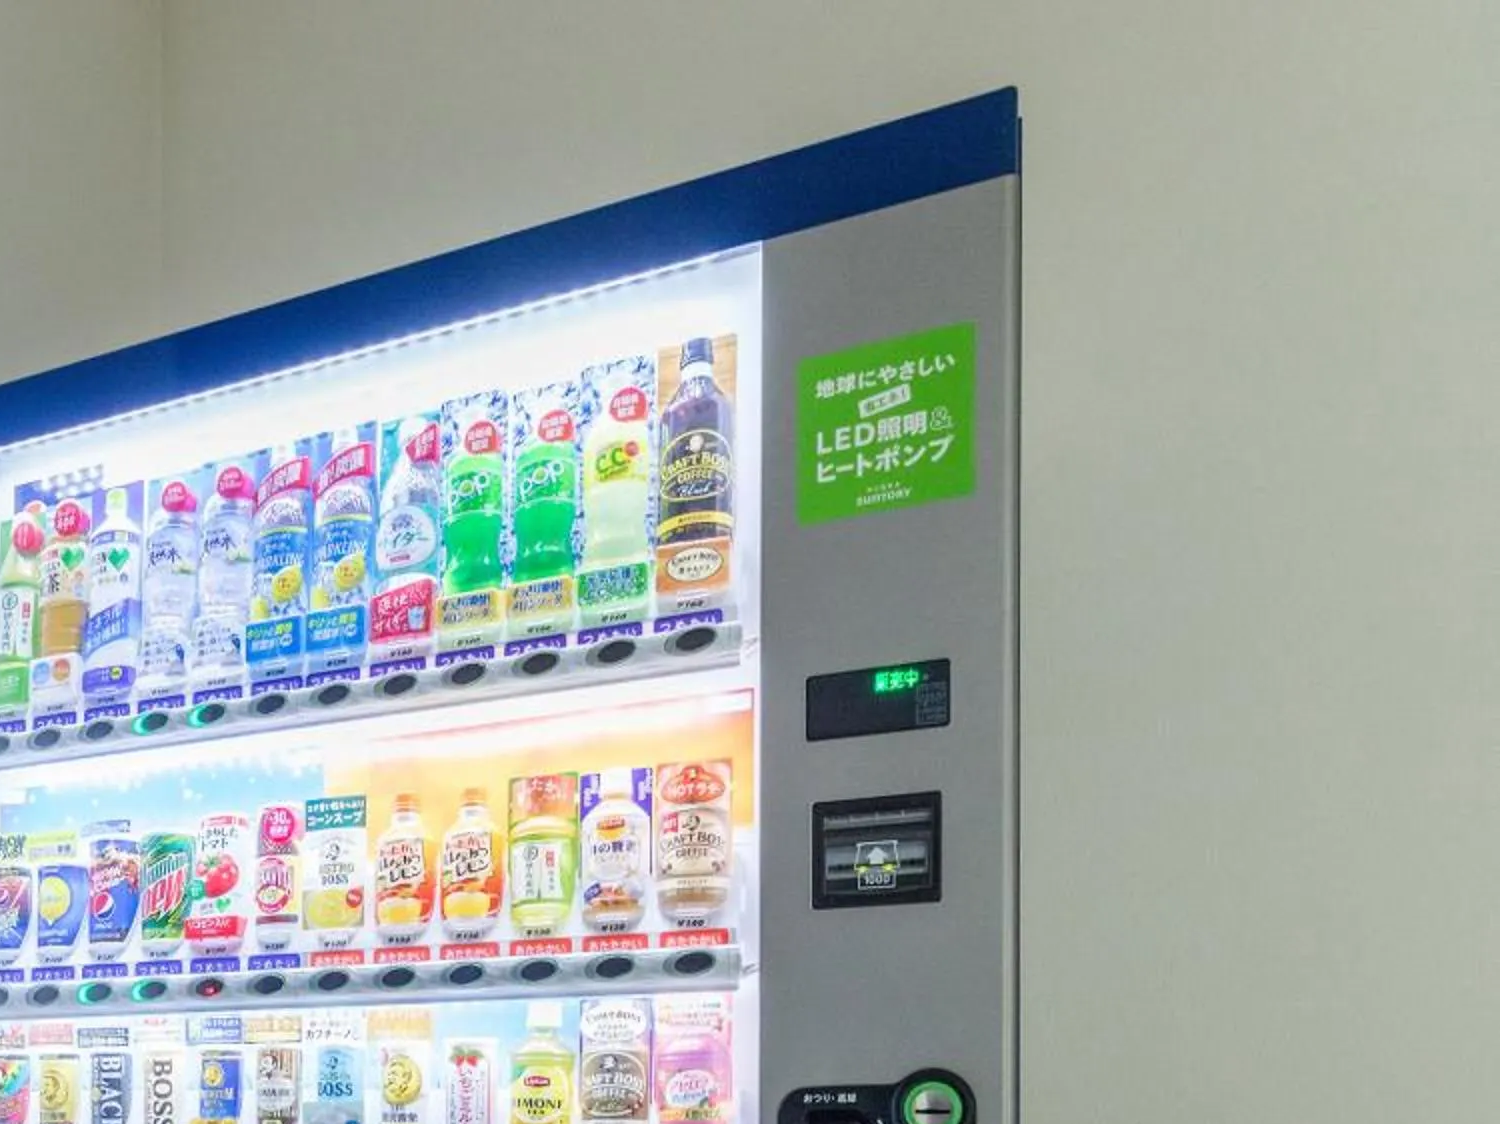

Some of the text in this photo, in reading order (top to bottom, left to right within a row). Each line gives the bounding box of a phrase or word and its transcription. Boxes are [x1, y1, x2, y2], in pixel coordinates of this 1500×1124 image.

[816, 354, 956, 399] 地球にやさしい
[816, 434, 955, 484] ヒートポンプ
[307, 811, 364, 827] コーンスープ
